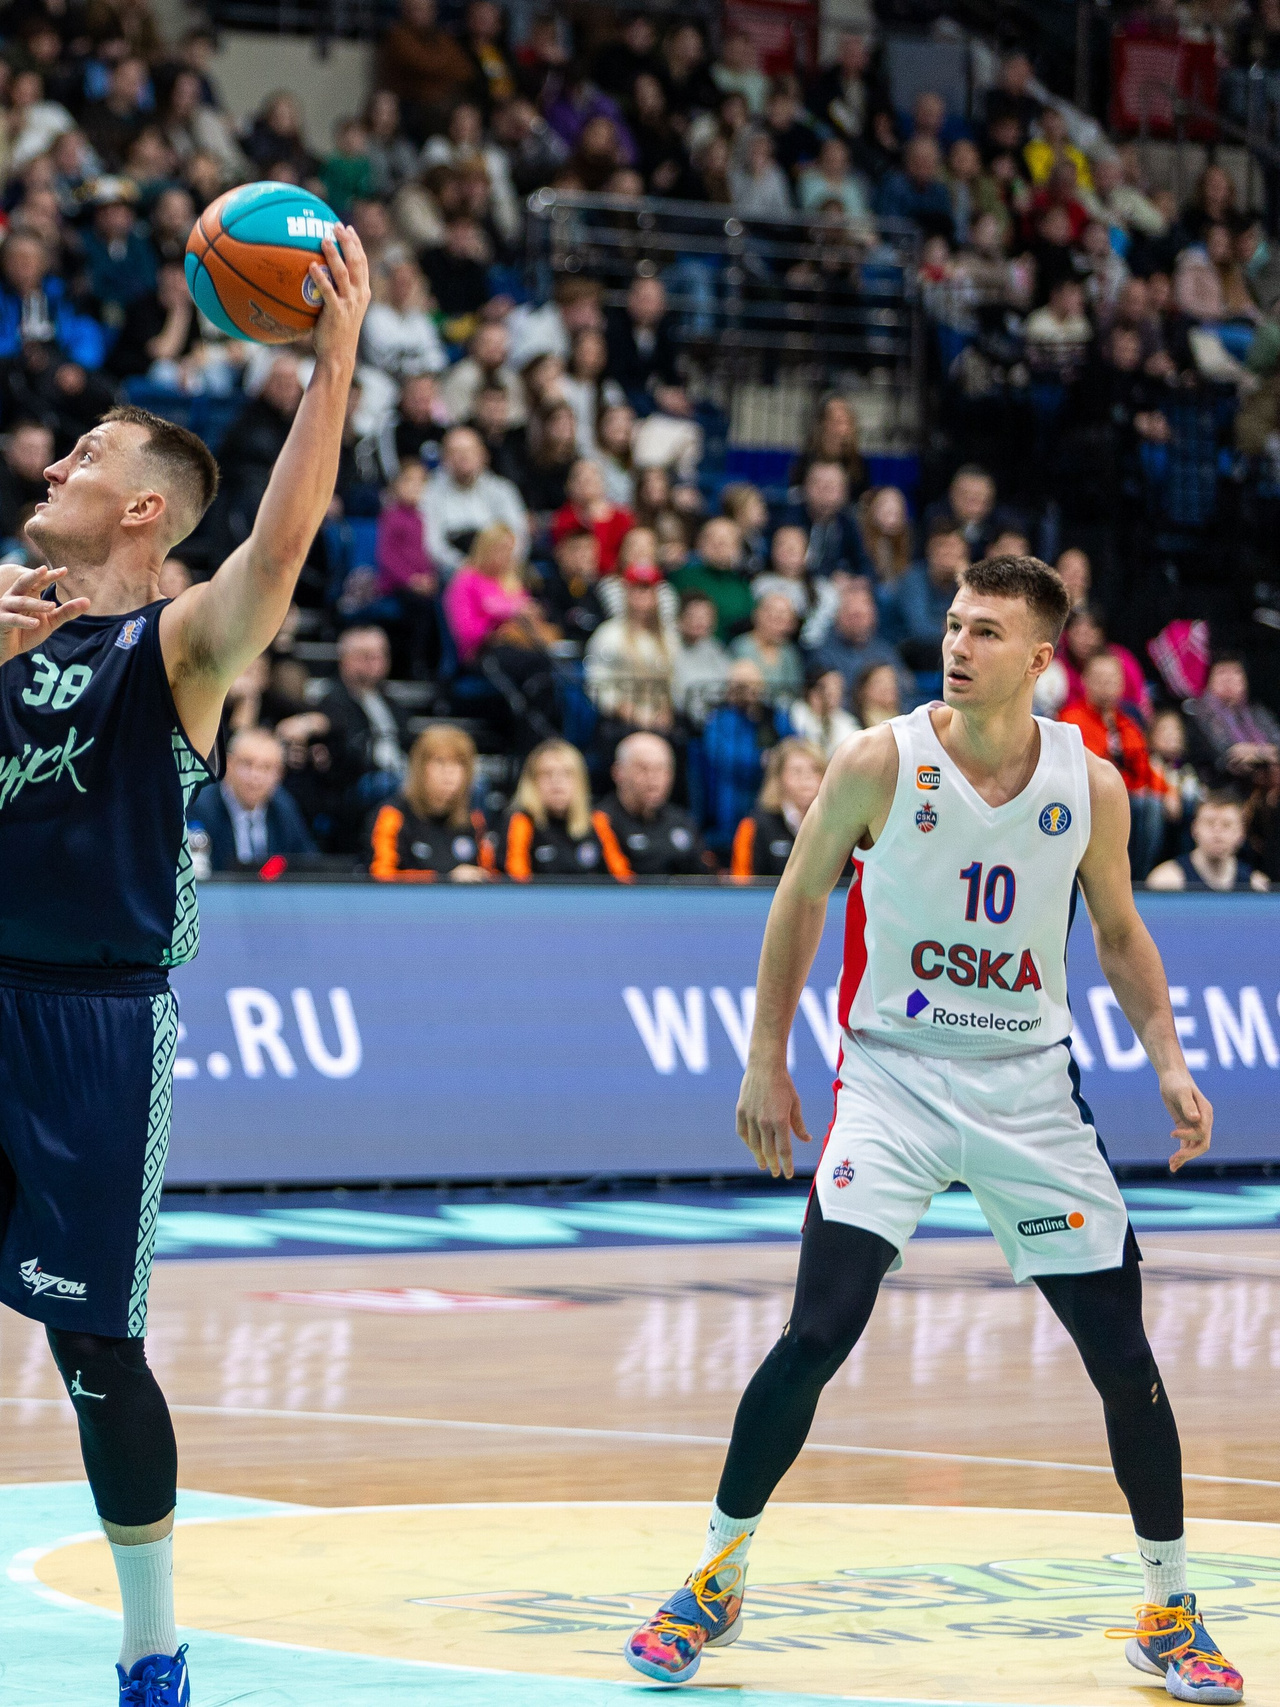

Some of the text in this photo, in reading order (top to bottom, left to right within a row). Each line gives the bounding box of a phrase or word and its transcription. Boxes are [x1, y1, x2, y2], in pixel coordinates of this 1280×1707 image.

[22, 653, 93, 710] 38
[921, 773, 940, 783] Win
[916, 813, 937, 823] CSKA
[959, 861, 1017, 925] 10
[910, 940, 1043, 992] CSKA
[932, 1007, 1043, 1032] Rostelecom
[834, 1169, 853, 1178] CSKA
[1021, 1219, 1066, 1235] Winline
